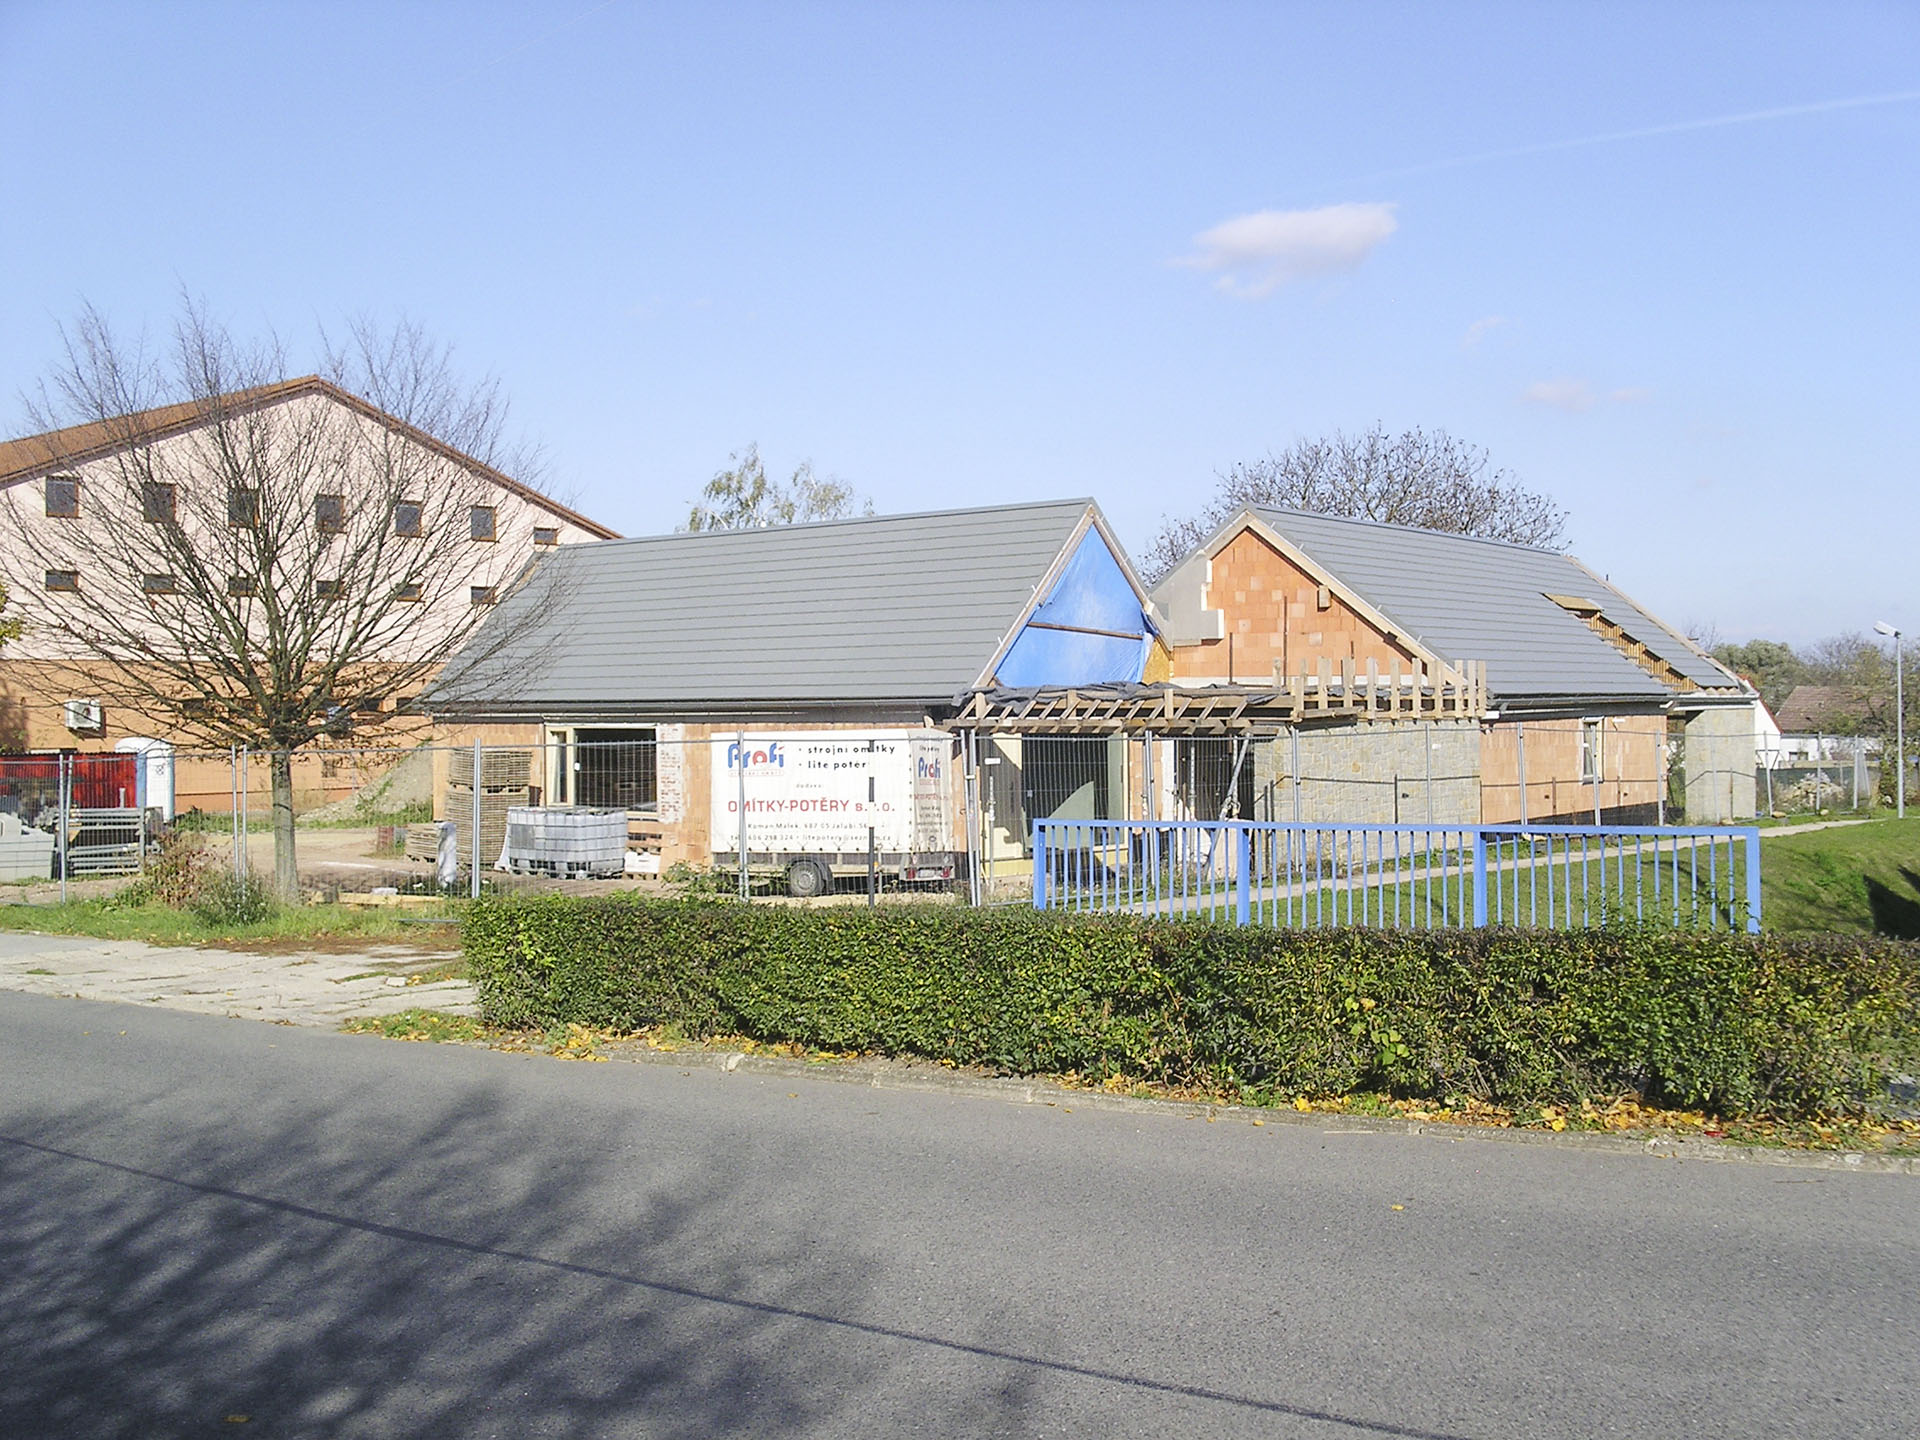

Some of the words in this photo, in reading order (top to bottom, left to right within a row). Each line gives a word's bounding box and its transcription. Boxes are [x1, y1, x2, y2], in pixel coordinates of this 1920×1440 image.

[853, 744, 895, 755] omtky
[728, 797, 849, 812] OMÍTKY-POTĚRY
[855, 802, 895, 812] s..o.
